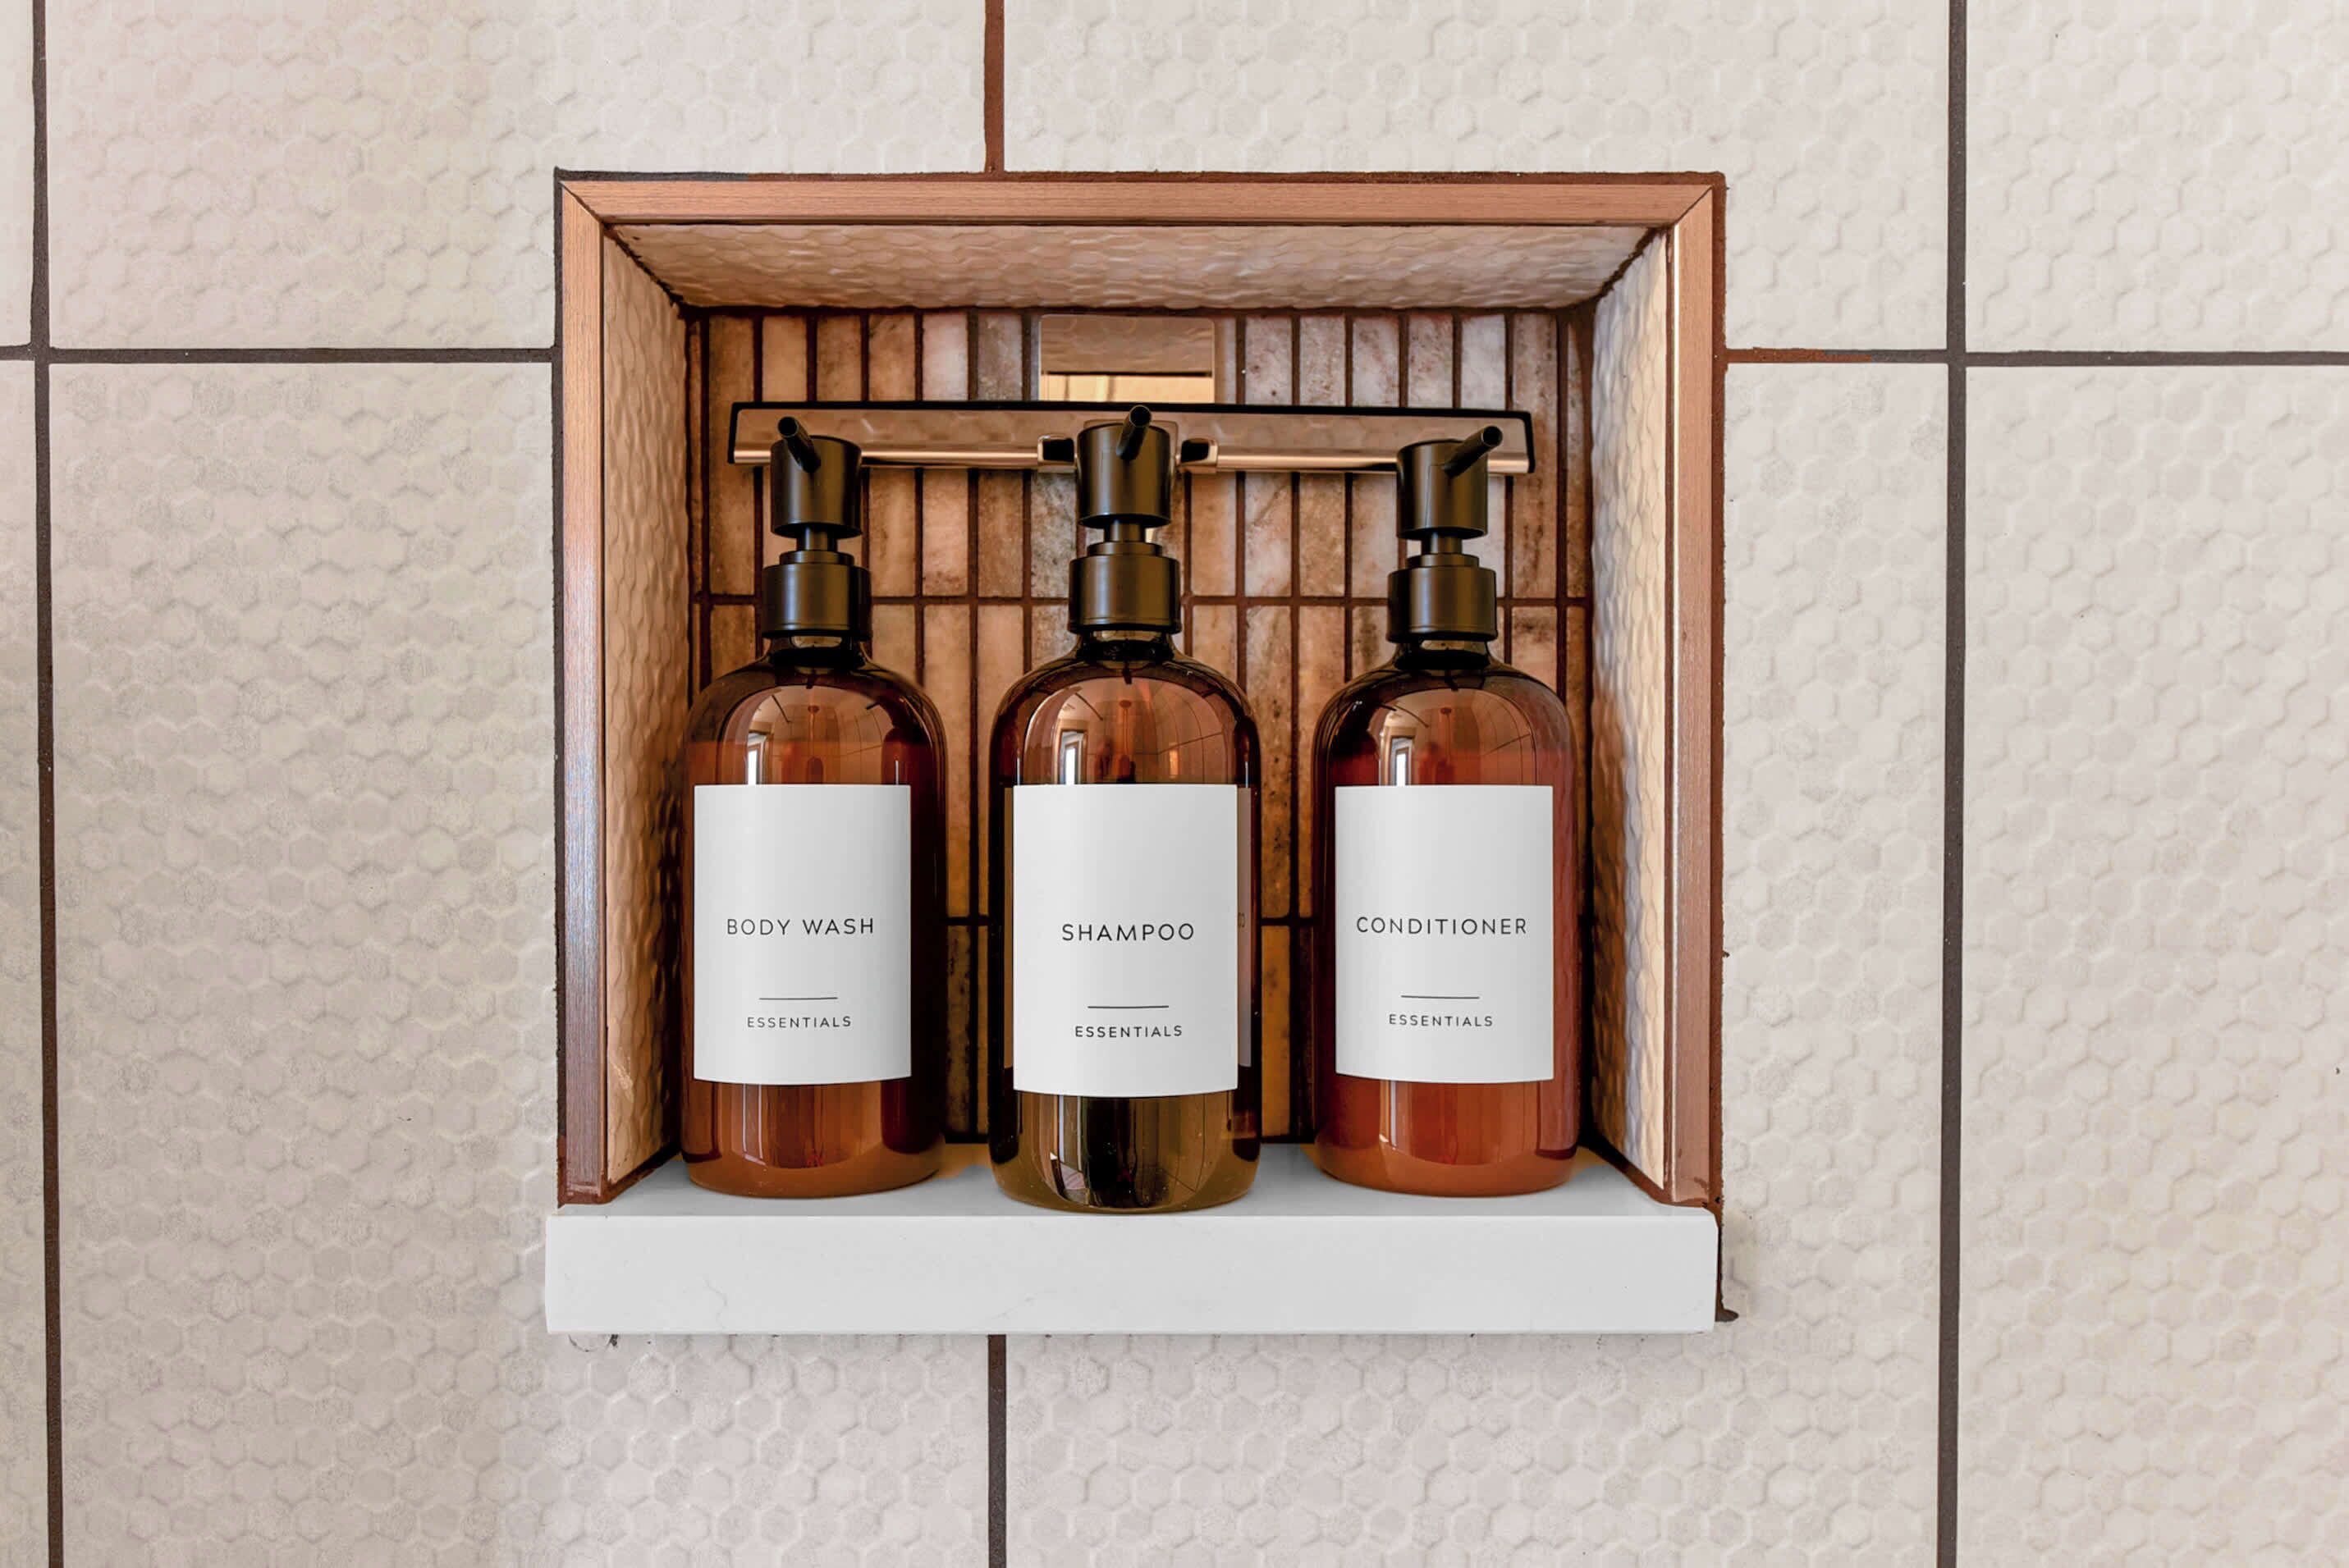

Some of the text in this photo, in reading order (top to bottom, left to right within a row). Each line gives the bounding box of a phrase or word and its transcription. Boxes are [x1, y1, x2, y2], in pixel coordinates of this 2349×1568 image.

[727, 917, 873, 935] BODY WASH
[1062, 922, 1194, 942] SHAMPOO
[1356, 916, 1527, 935] CONDITIONER
[747, 1015, 851, 1028] ESSENTIALS
[1389, 1013, 1493, 1027] ESSENTIALS
[1074, 1025, 1183, 1038] ESSENTIALS
